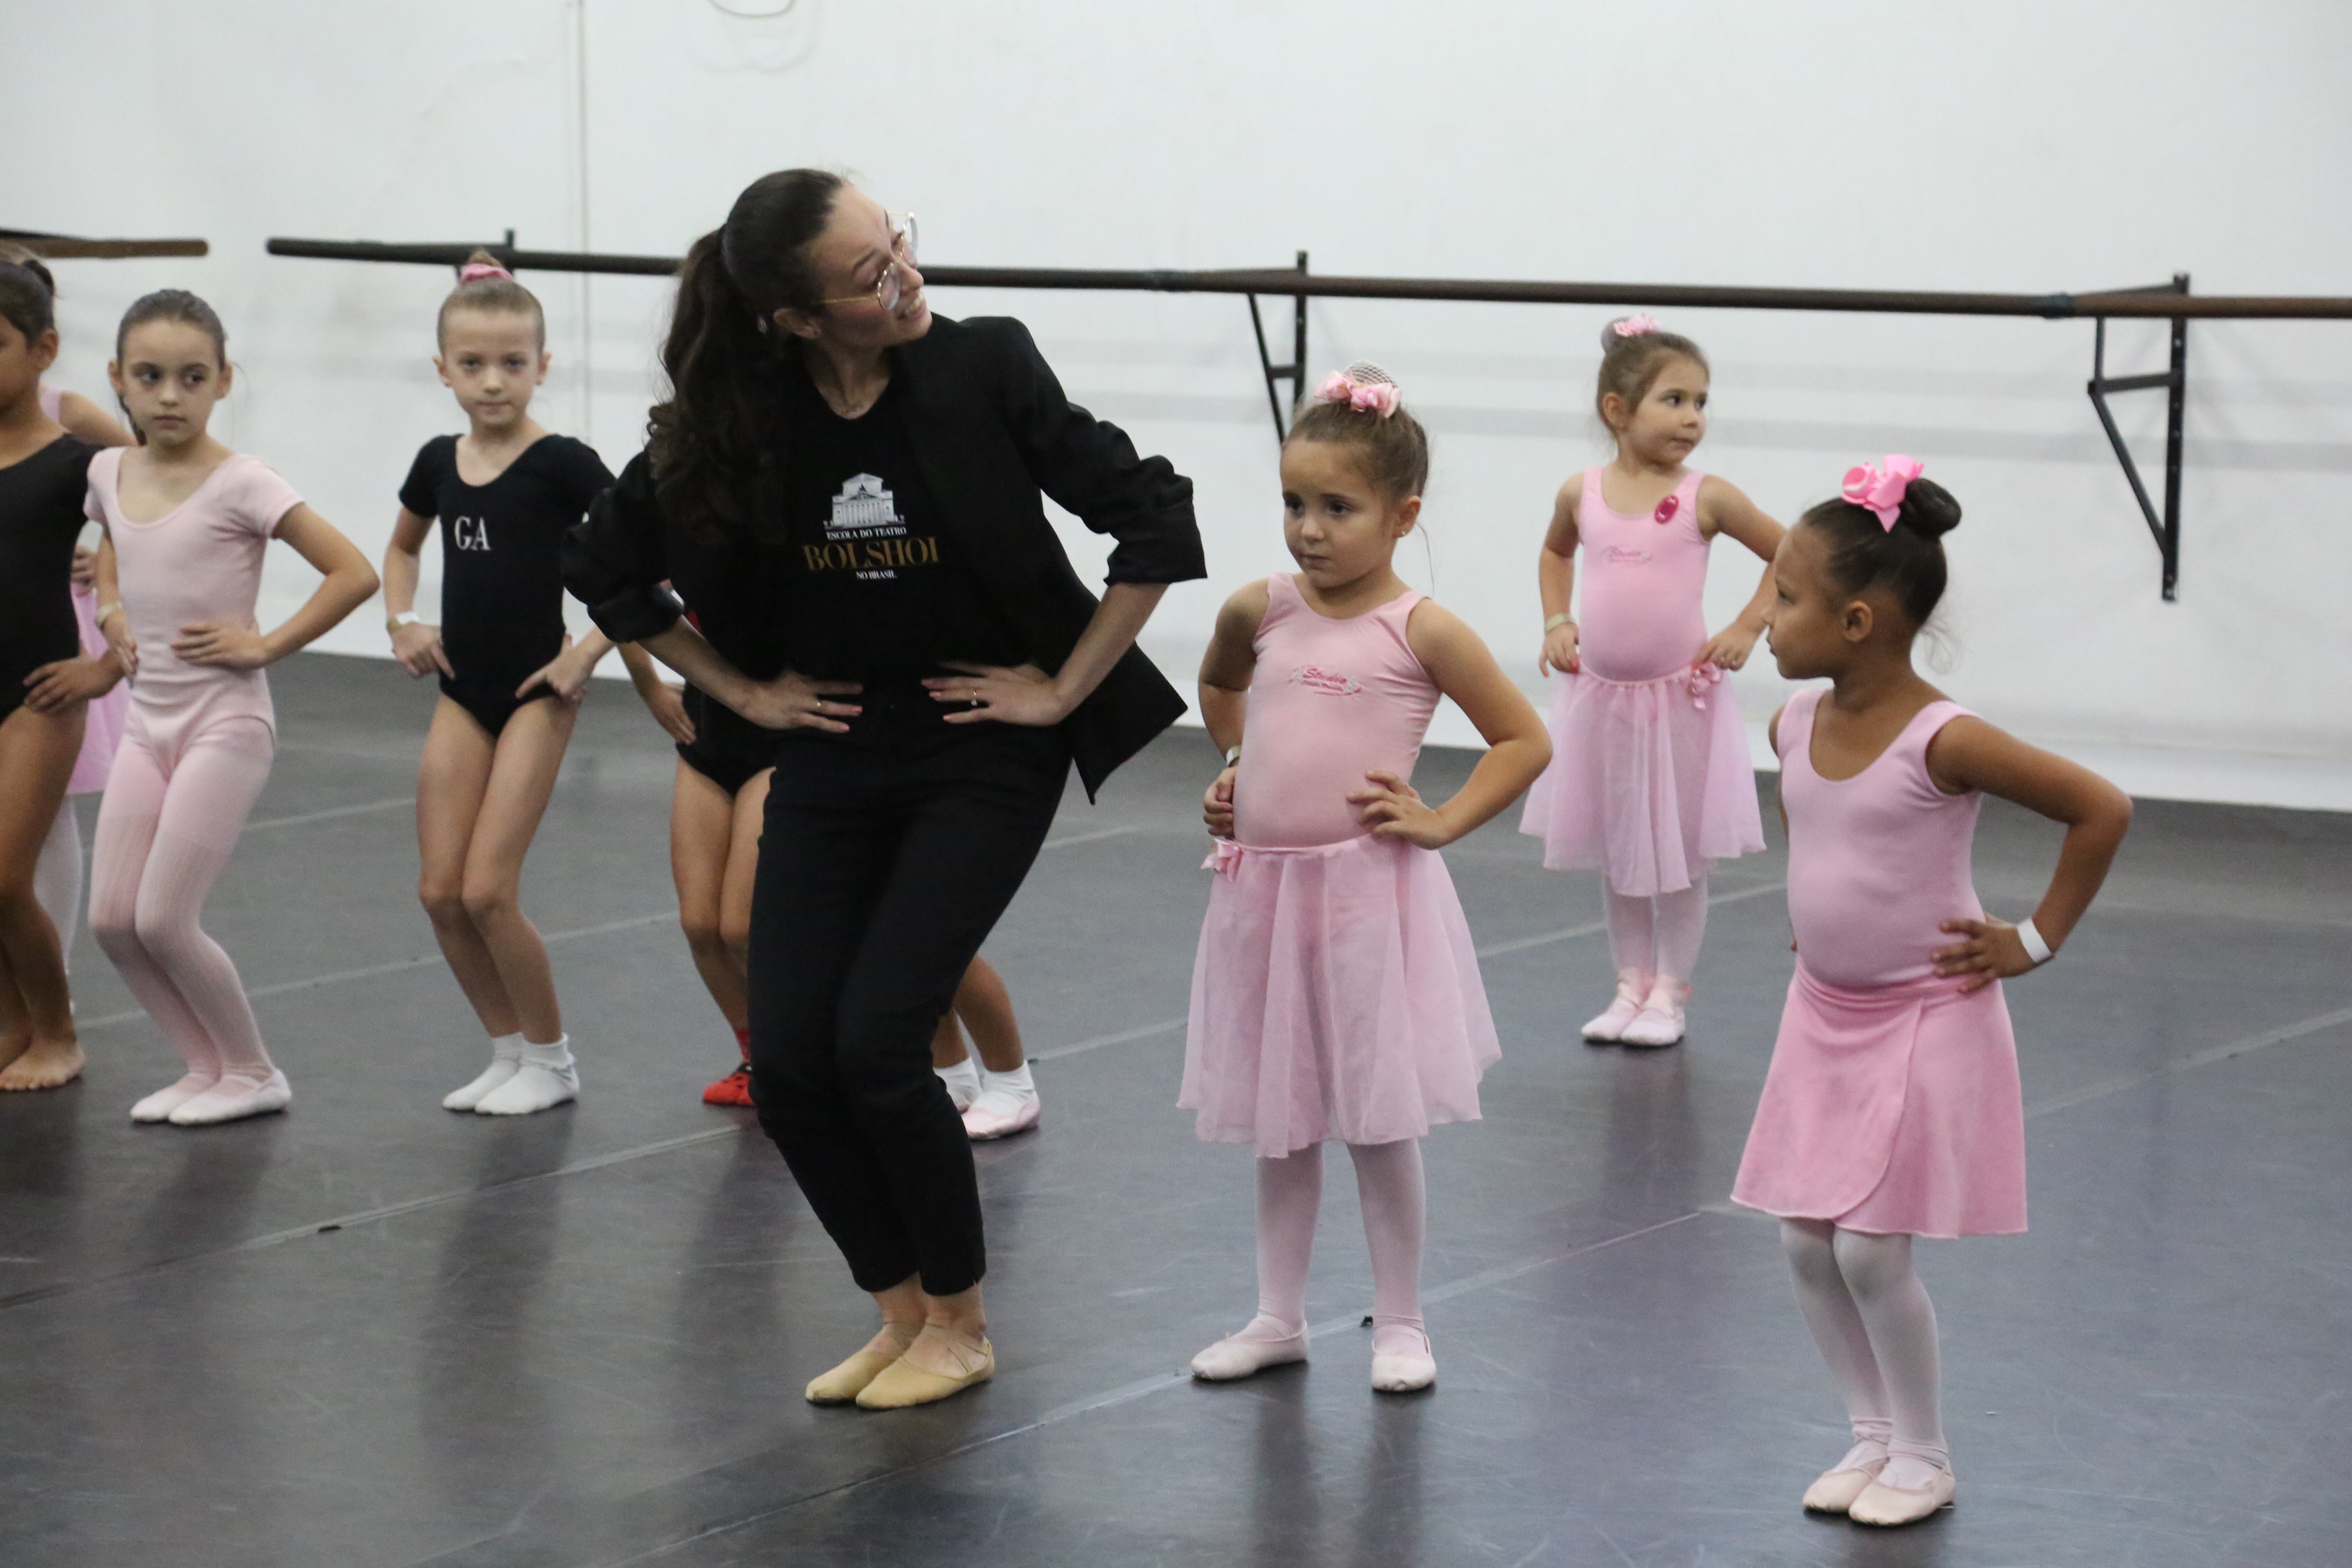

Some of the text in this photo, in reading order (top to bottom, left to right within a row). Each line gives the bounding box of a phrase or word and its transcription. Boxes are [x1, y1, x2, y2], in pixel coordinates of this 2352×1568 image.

[454, 516, 491, 550] GA
[826, 526, 906, 541] ESCOLA DO TEATRO
[802, 537, 939, 571] BOLSHOI
[856, 570, 897, 579] NO BRASIL
